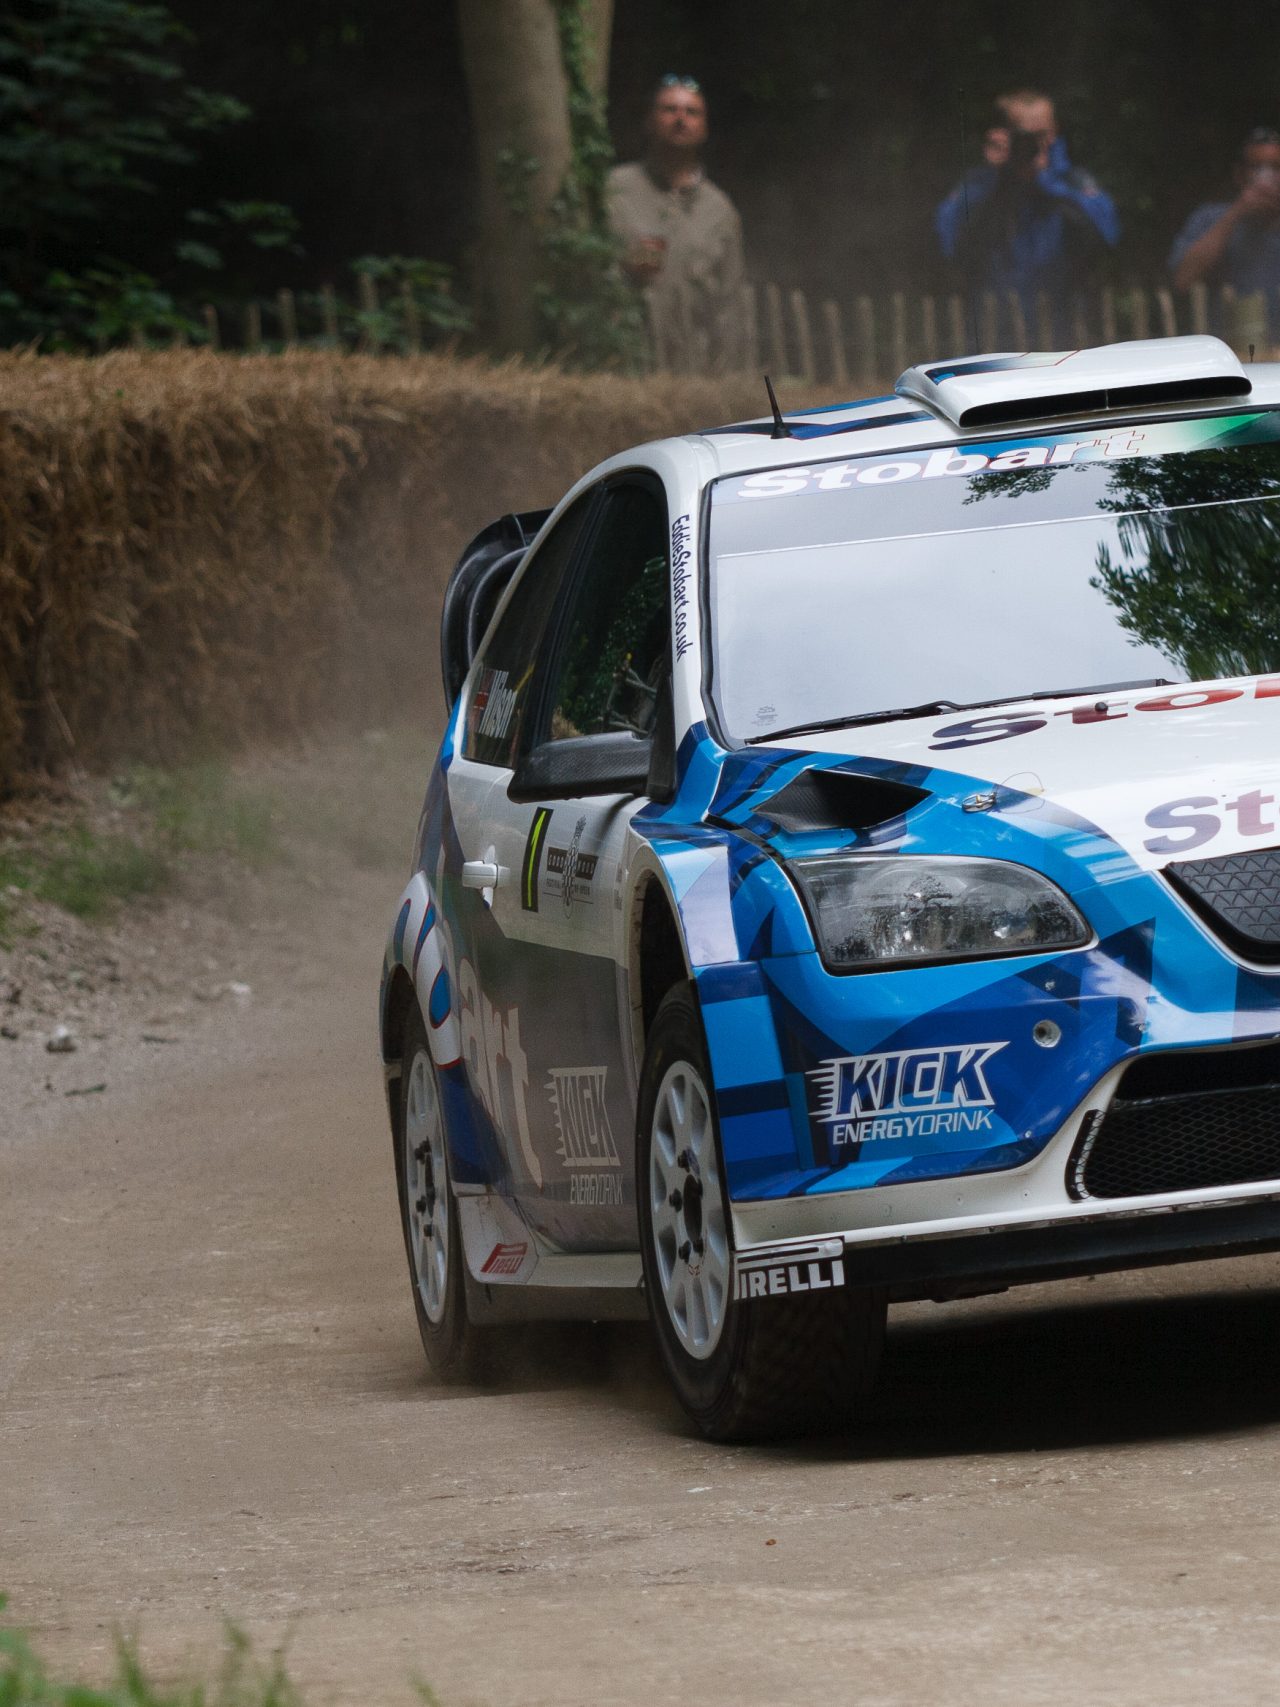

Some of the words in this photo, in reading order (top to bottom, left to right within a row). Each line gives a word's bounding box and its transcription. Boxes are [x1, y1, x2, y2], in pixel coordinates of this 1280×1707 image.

[737, 430, 1146, 499] Stobart
[671, 513, 694, 663] EddieStobart.co.uk
[549, 1066, 621, 1166] KICK
[815, 1043, 1006, 1121] KICK
